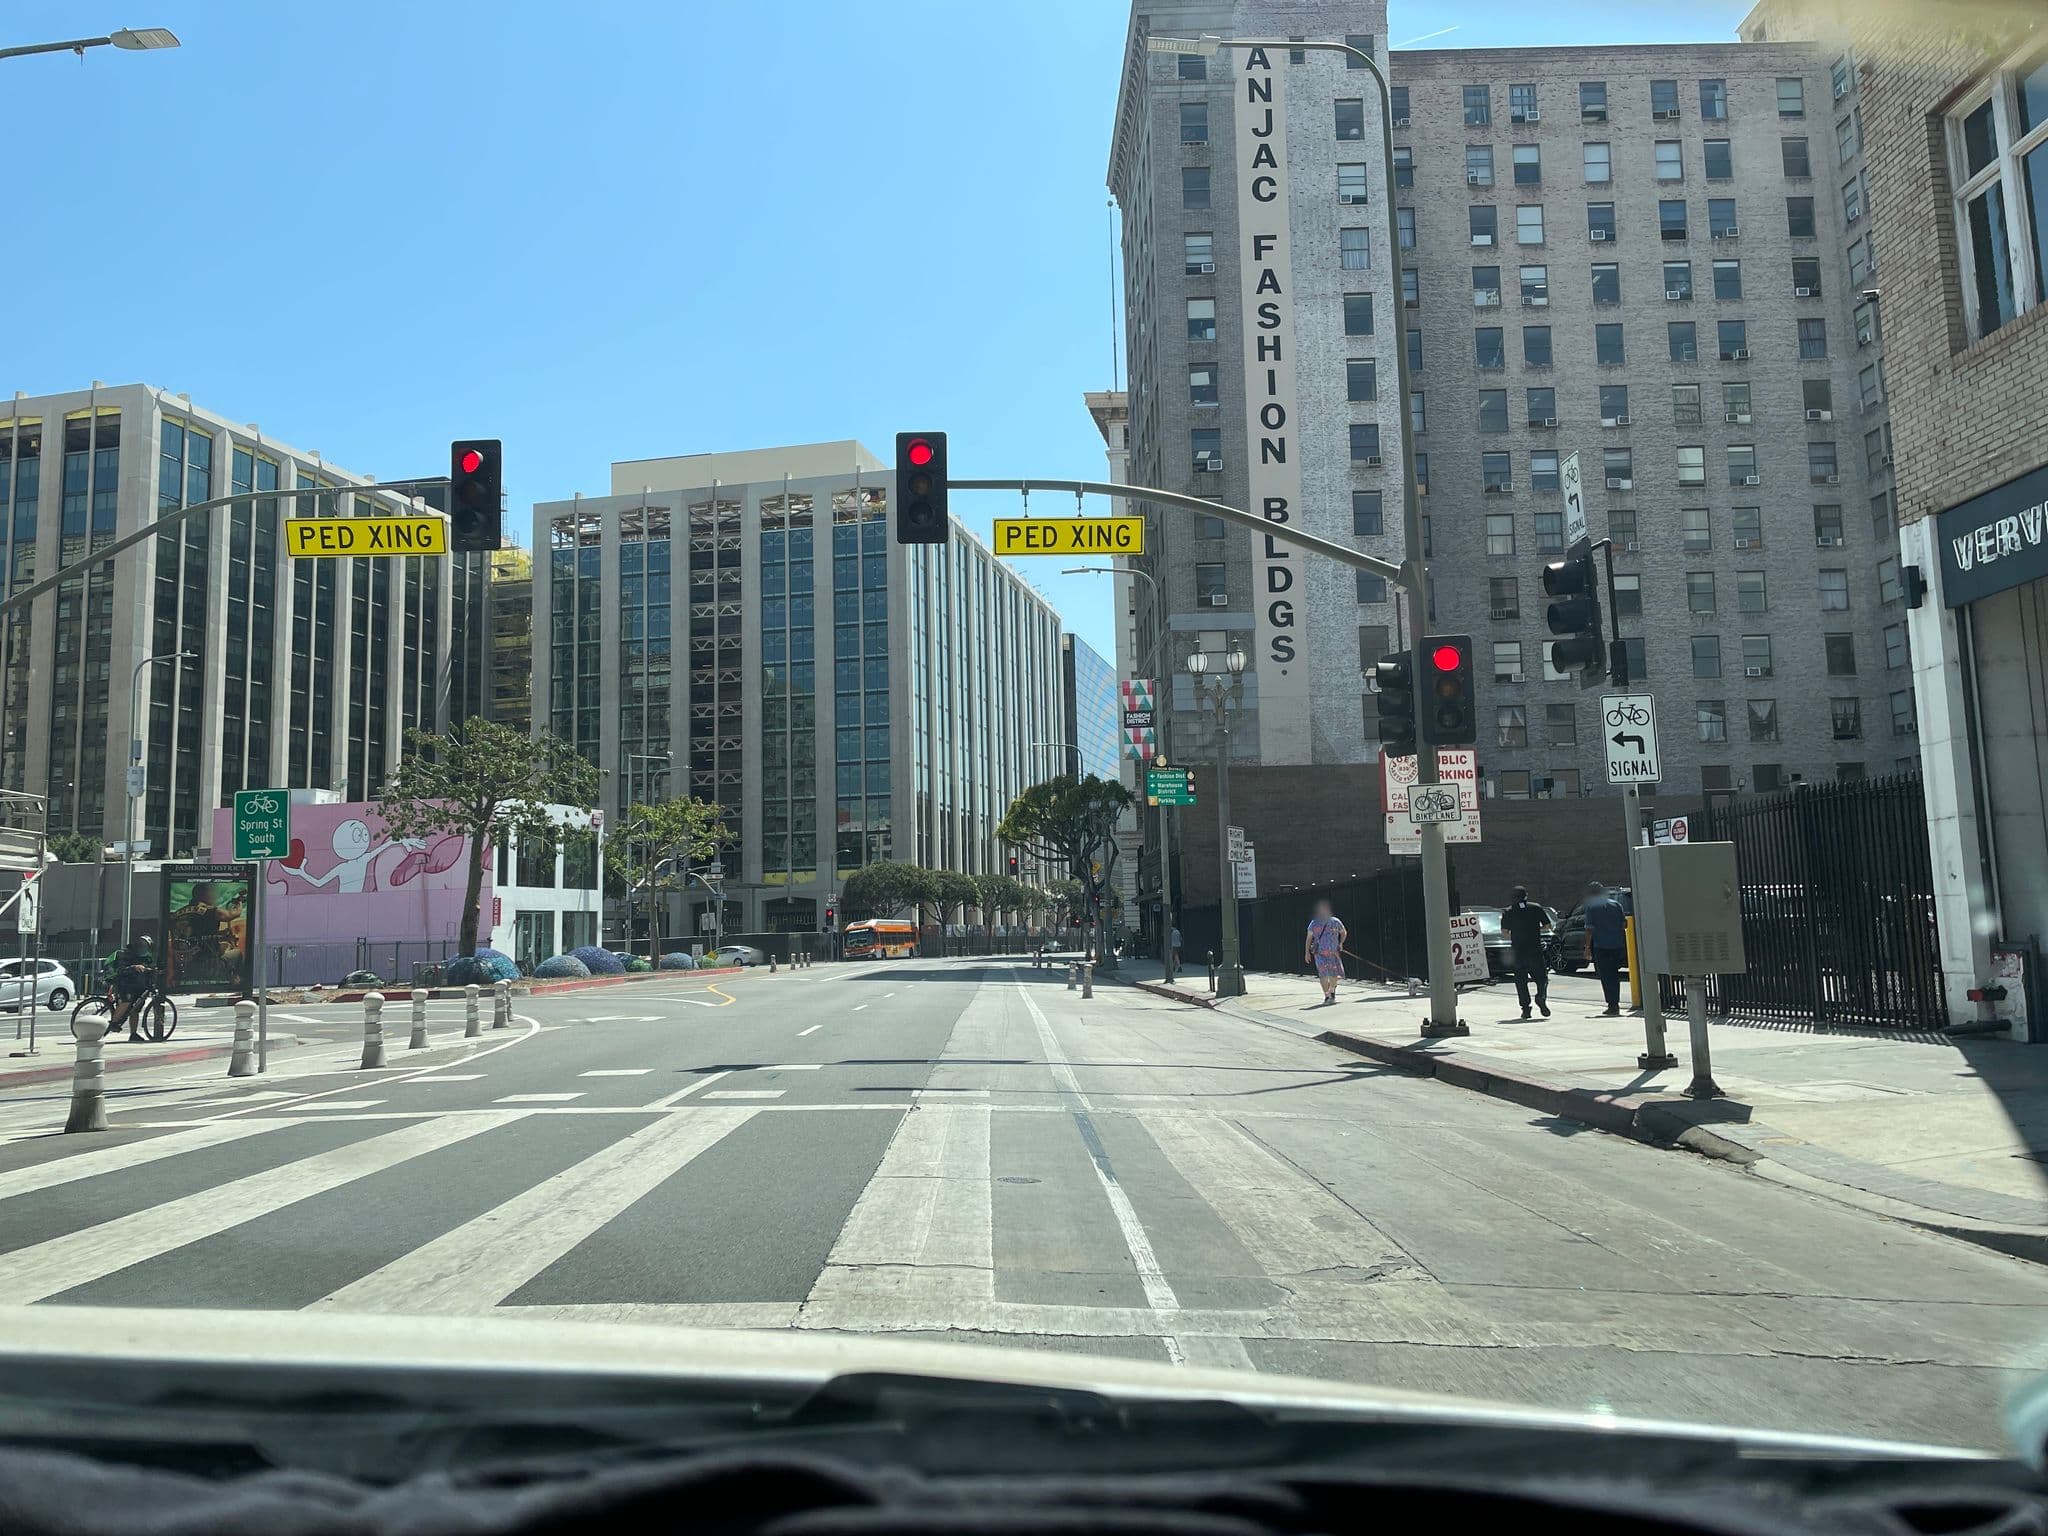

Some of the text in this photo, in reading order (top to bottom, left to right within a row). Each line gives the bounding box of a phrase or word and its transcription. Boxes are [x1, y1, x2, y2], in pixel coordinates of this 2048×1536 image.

[1245, 47, 1296, 676] ANJAC FASHION BLDGS.
[1569, 516, 1585, 537] SIGNAL
[299, 524, 432, 549] PED XING
[1006, 524, 1131, 548] PED XING
[1126, 712, 1151, 720] FASHION
[1438, 754, 1468, 765] BLIC
[1610, 759, 1657, 777] SIGNAL
[1439, 769, 1474, 780] RKING
[1415, 810, 1456, 821] BIKE LANE
[240, 818, 283, 832] Spring St
[248, 833, 275, 844] South
[1229, 829, 1243, 839] RIGHT
[1231, 840, 1243, 849] TURN
[1229, 850, 1243, 860] ONLY
[211, 864, 246, 872] DISTRICT
[21, 917, 34, 929] ONLY
[1450, 917, 1477, 928] BLIC
